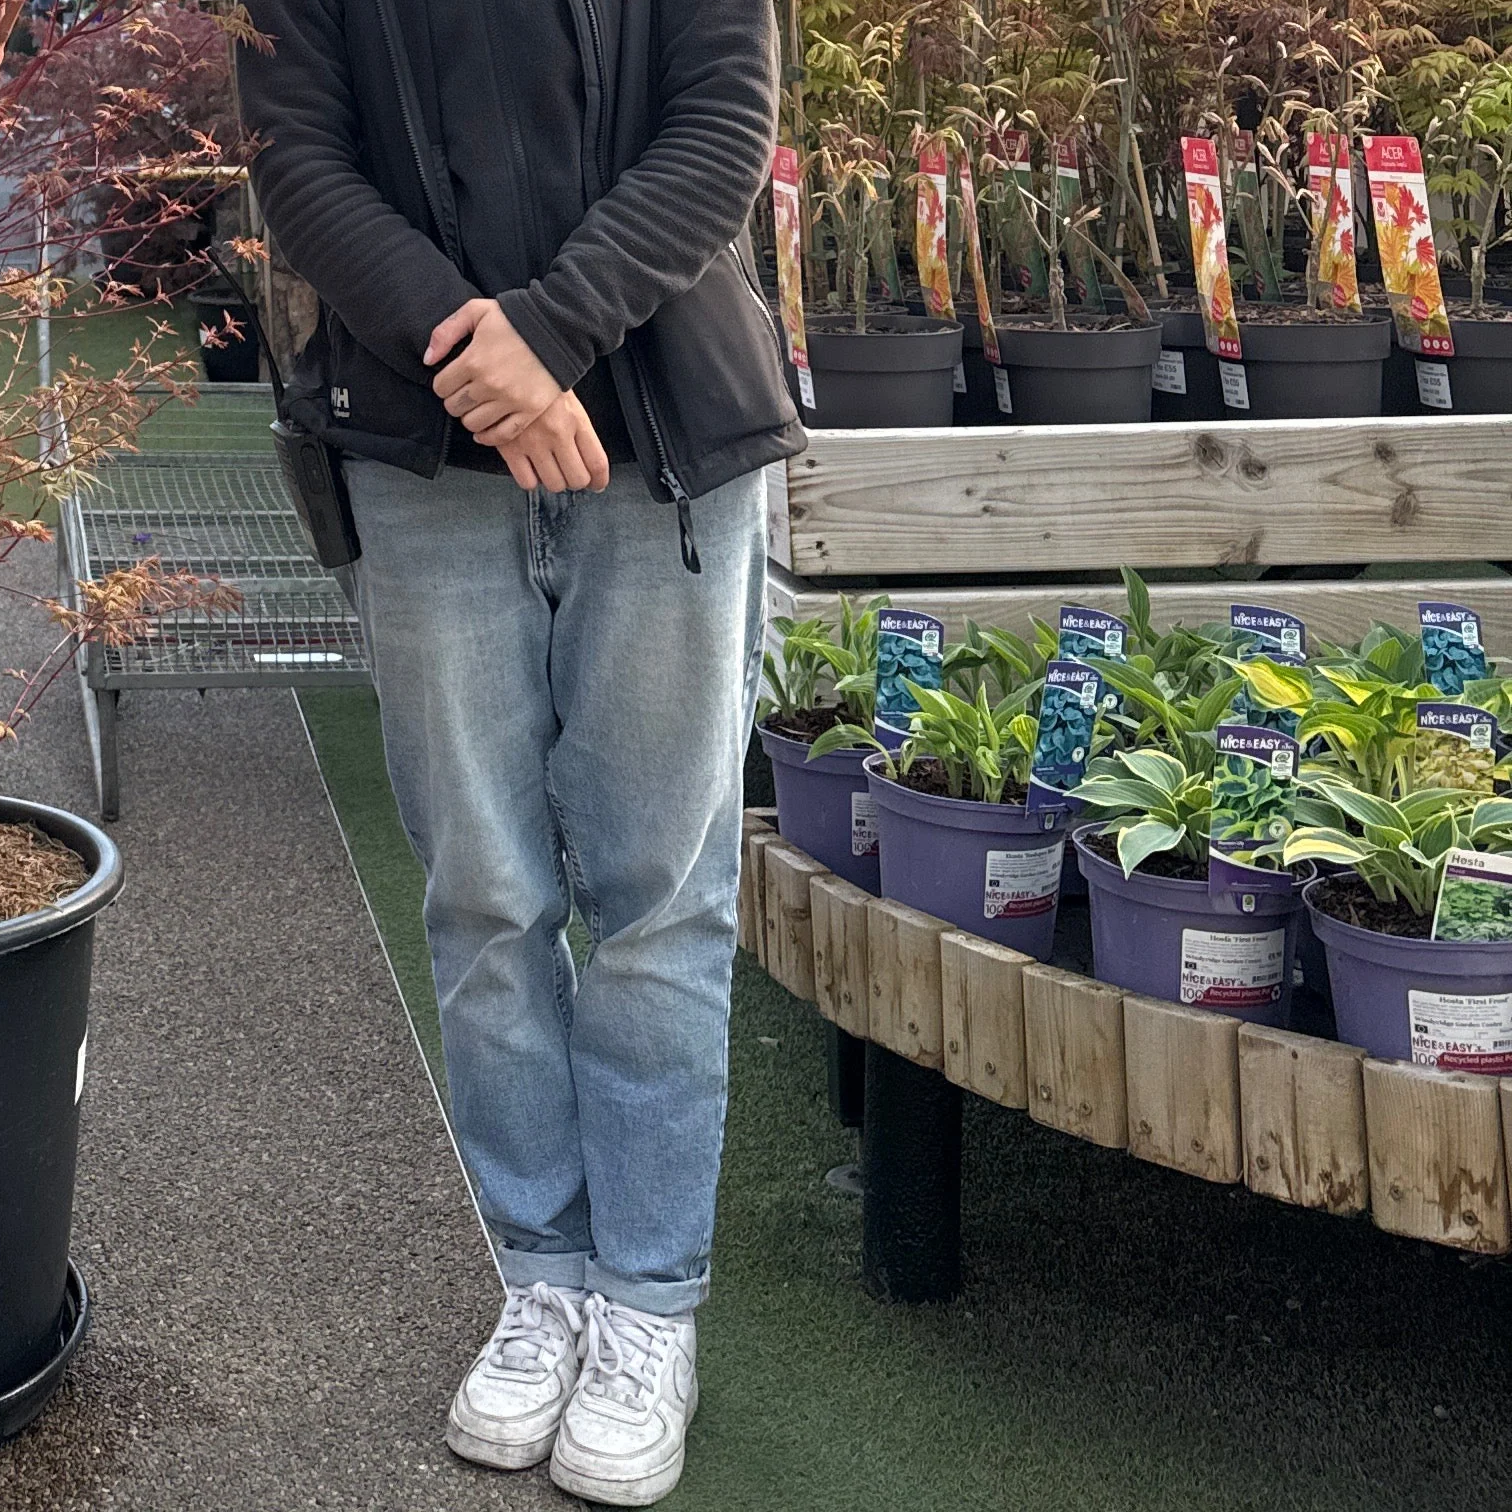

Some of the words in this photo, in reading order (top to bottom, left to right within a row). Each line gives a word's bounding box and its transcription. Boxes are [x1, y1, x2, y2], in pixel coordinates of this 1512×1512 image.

[1381, 146, 1404, 159] ACER
[1451, 854, 1485, 868] Hosta
[1209, 989, 1241, 998] Recycled
[1444, 1054, 1480, 1064] Recycled
[1480, 1055, 1504, 1065] plastic
